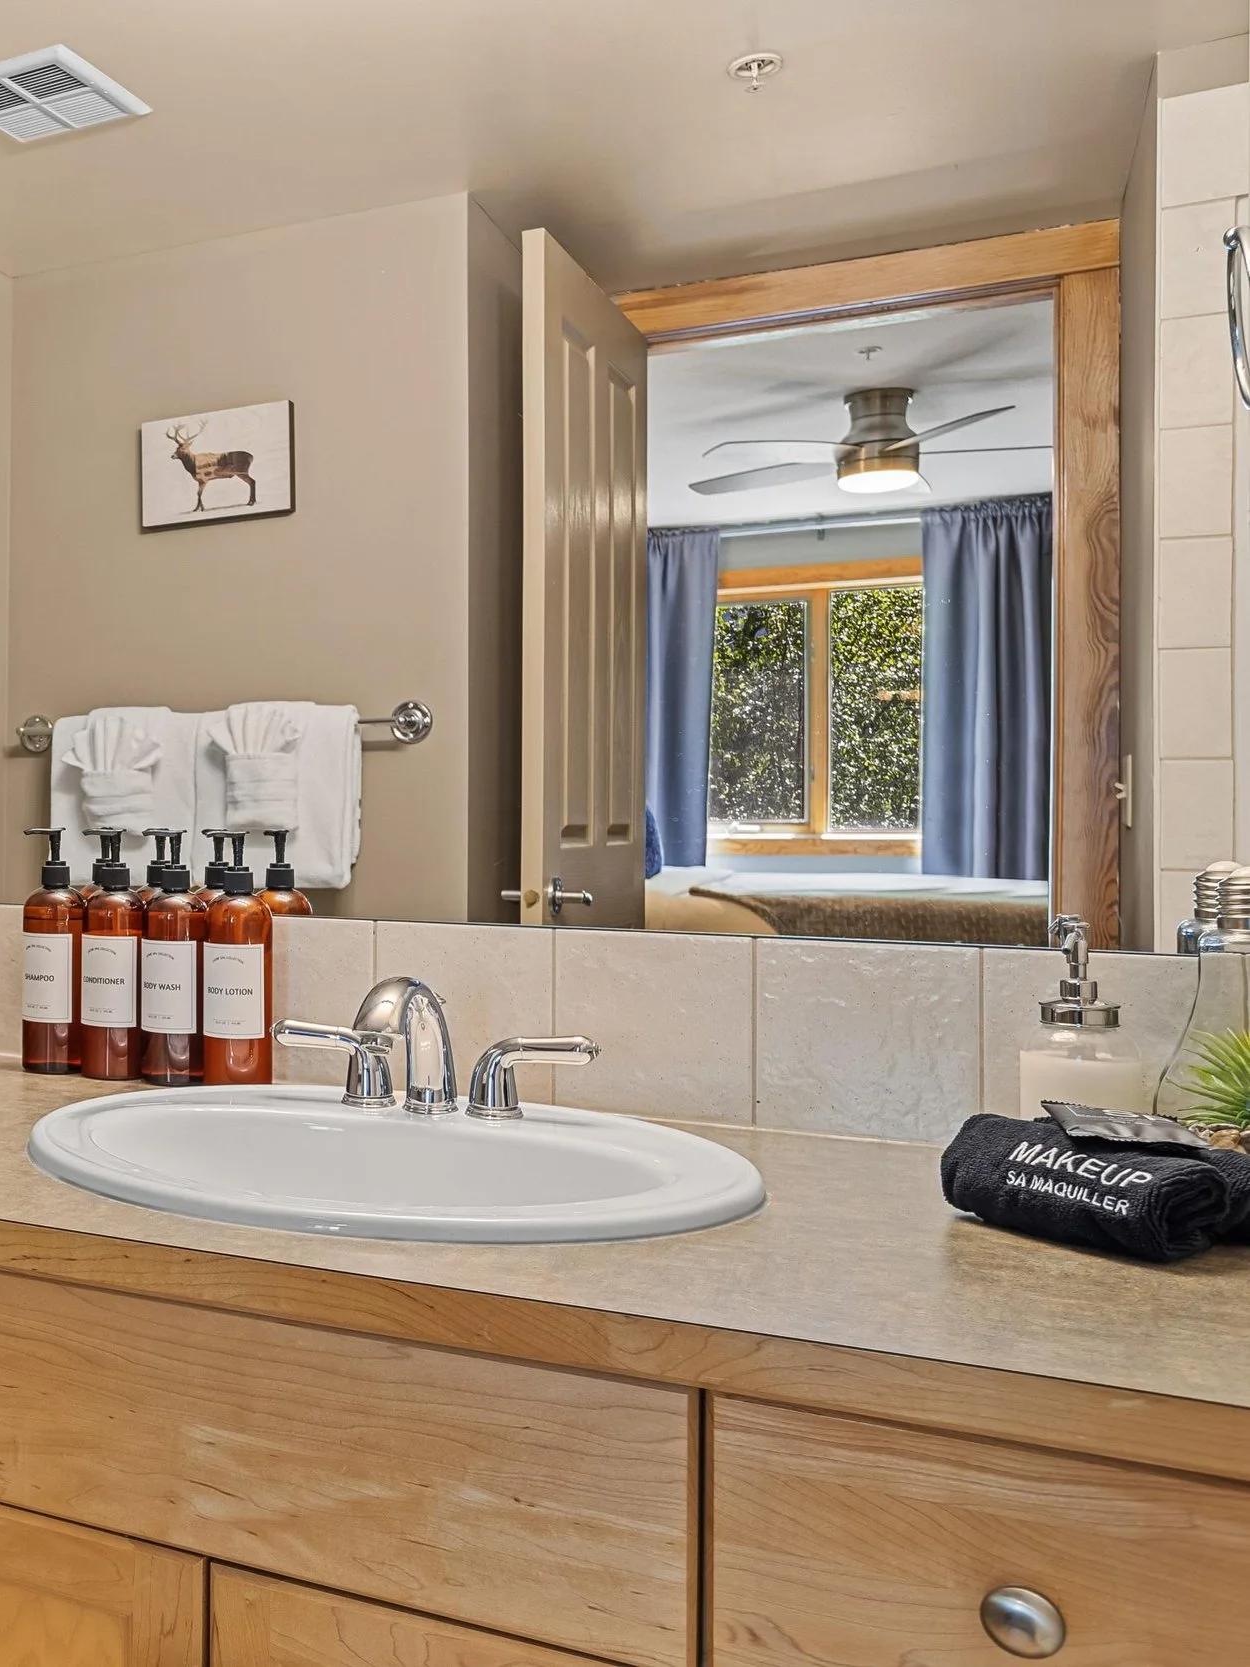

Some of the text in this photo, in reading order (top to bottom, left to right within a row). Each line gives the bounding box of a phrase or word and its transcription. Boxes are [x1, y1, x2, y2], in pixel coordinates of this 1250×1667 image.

[25, 973, 55, 982] SHAMPOO
[83, 975, 125, 985] CONDITIONER
[143, 981, 181, 991] BODY WASH
[207, 986, 253, 996] BODY LOTION
[1008, 1141, 1152, 1187] MAKEUP
[1006, 1170, 1129, 1215] SA MAQUILLER
